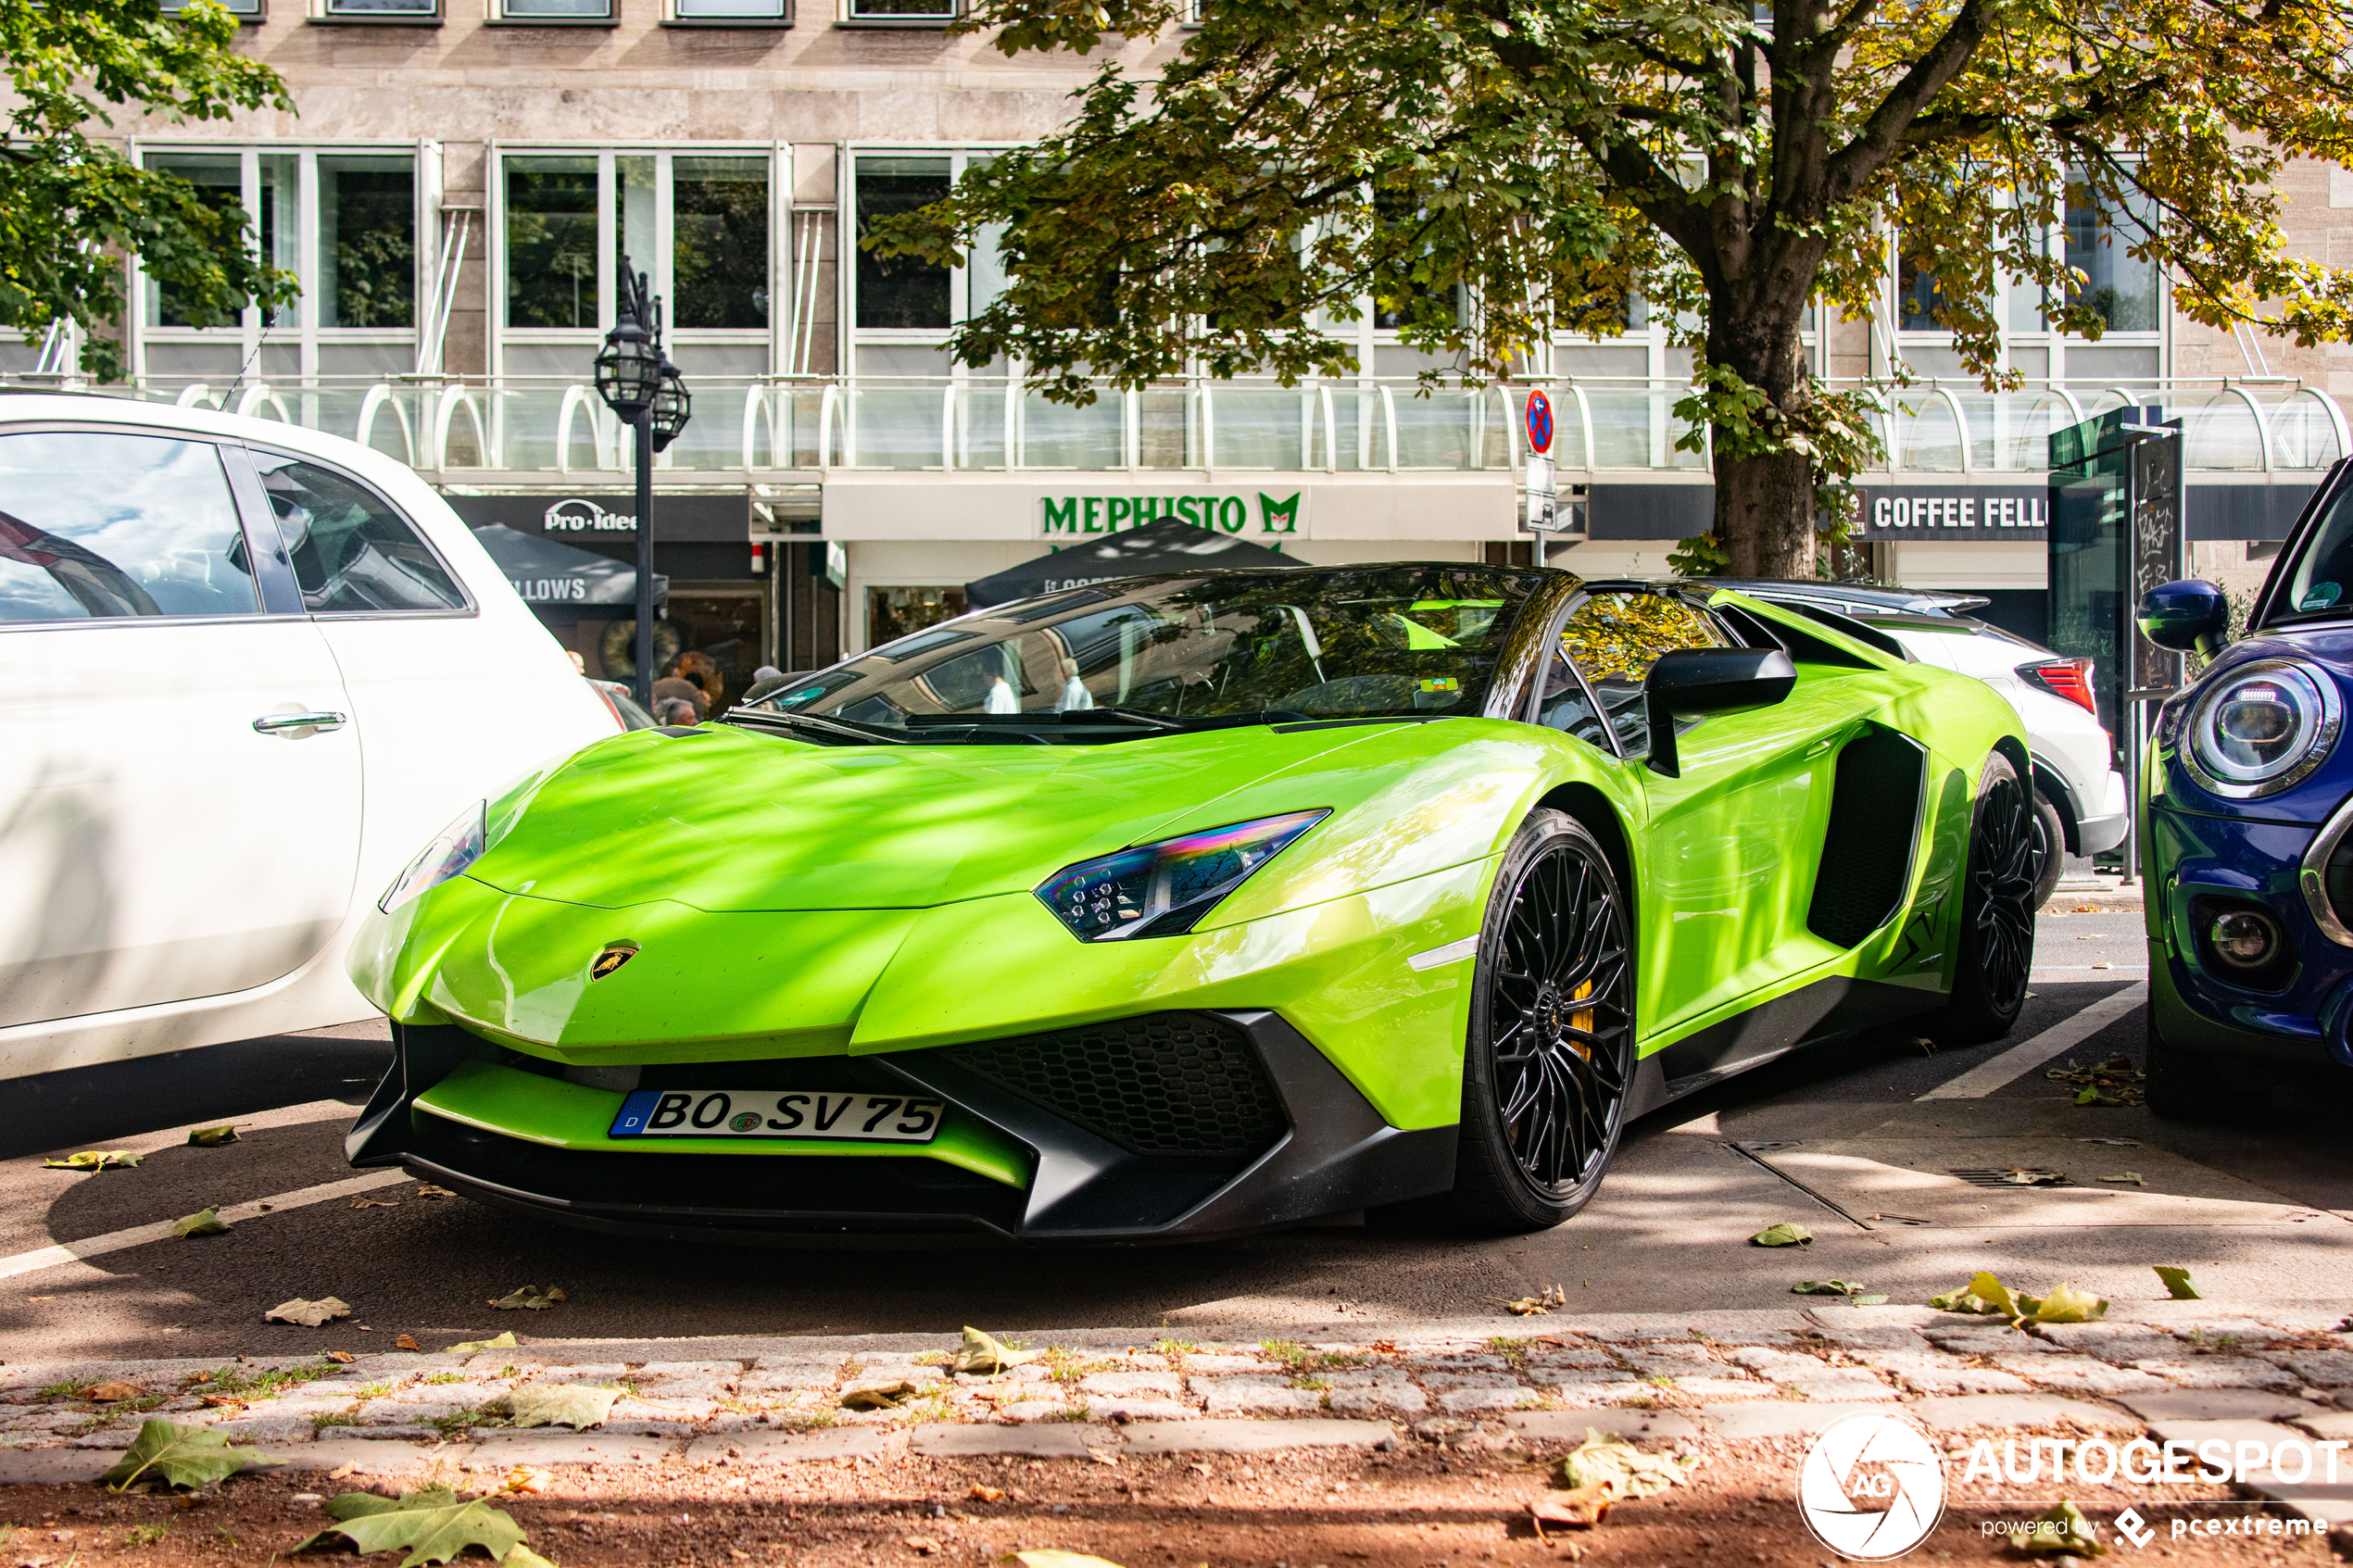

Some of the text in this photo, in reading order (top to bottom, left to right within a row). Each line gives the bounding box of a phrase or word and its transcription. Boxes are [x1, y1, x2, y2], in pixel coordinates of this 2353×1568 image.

[1042, 495, 1247, 533] MEPHISTO
[1874, 497, 2049, 528] COFFEE FELL
[510, 578, 585, 601] LLOWS
[624, 1117, 638, 1127] D
[648, 1093, 941, 1135] BO SV 75
